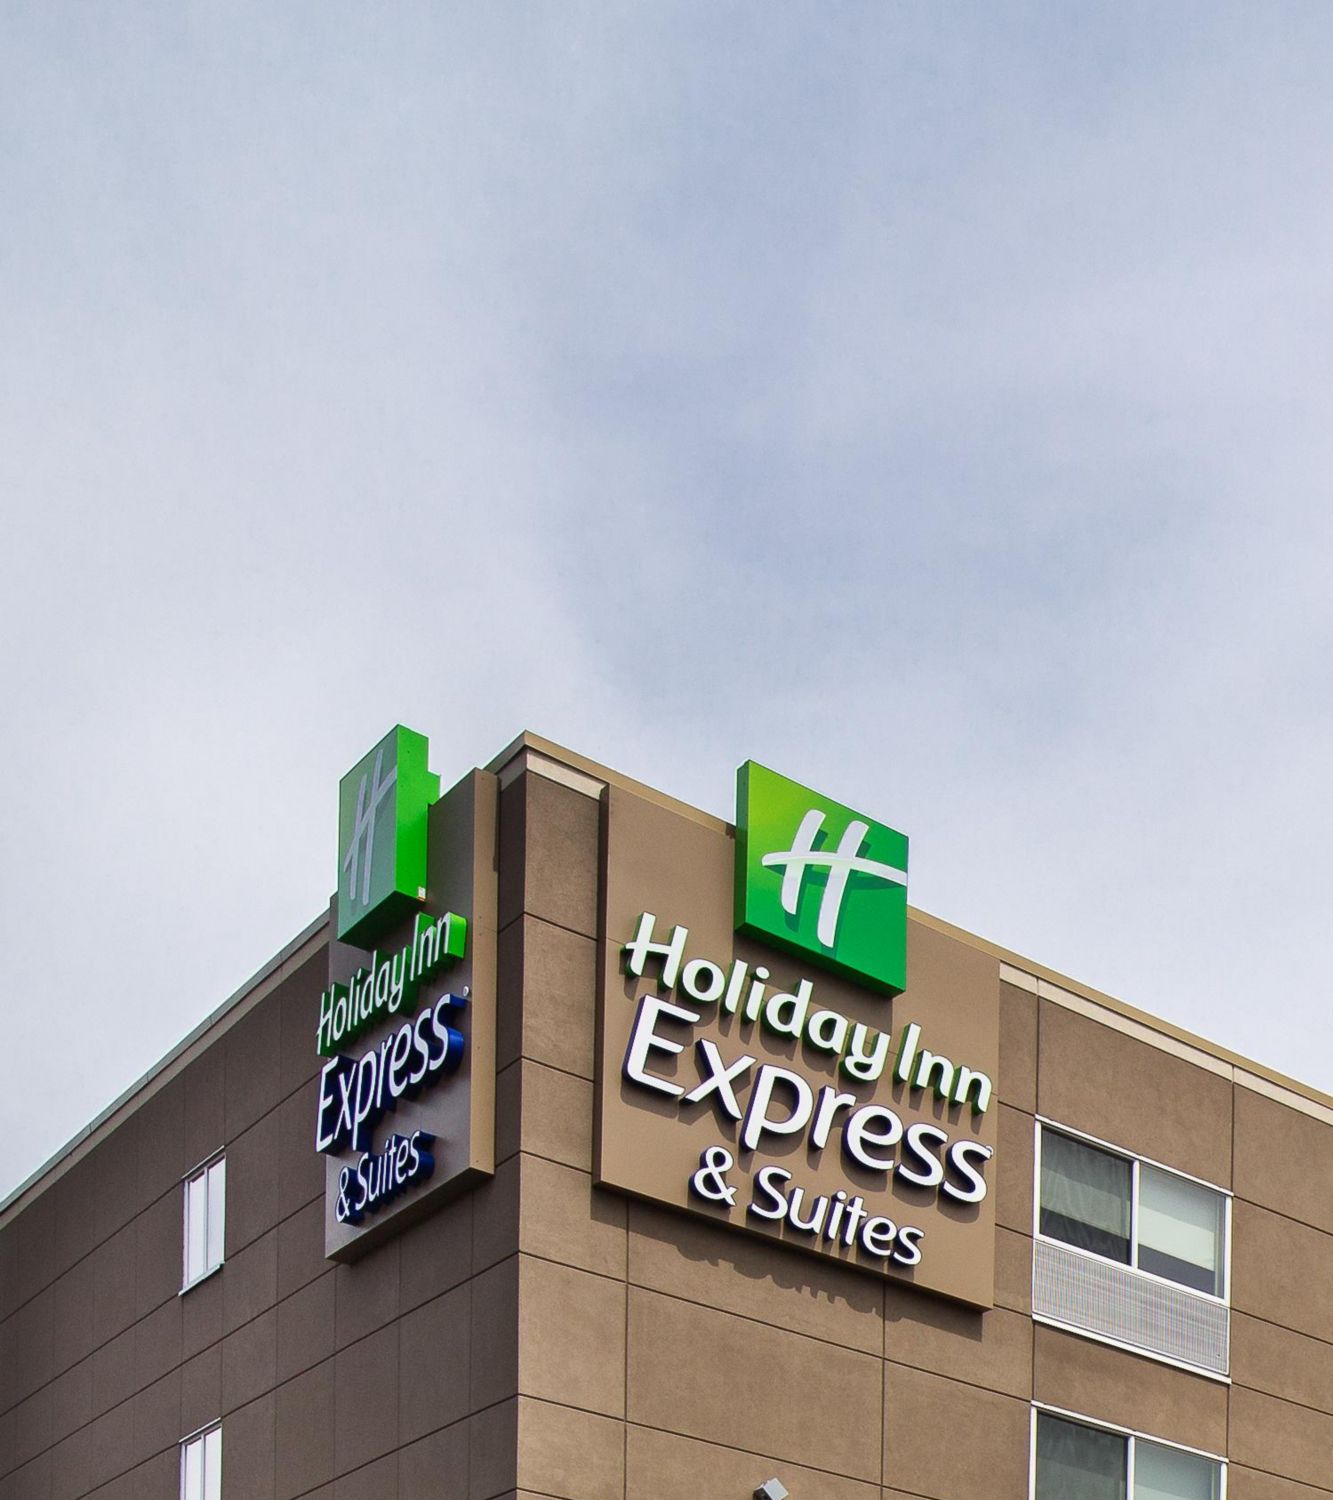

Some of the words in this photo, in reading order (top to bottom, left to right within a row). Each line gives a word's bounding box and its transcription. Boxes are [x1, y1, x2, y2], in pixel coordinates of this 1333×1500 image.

[316, 947, 407, 1055] Holiday
[410, 911, 452, 982] Inn
[625, 911, 891, 1081] Holiday
[898, 1022, 993, 1113] Inn
[316, 993, 451, 1152] Express
[624, 993, 990, 1204] Express
[335, 1166, 351, 1223] &
[355, 1130, 421, 1211] Suites
[692, 1145, 738, 1207] &
[750, 1165, 925, 1267] Suites
